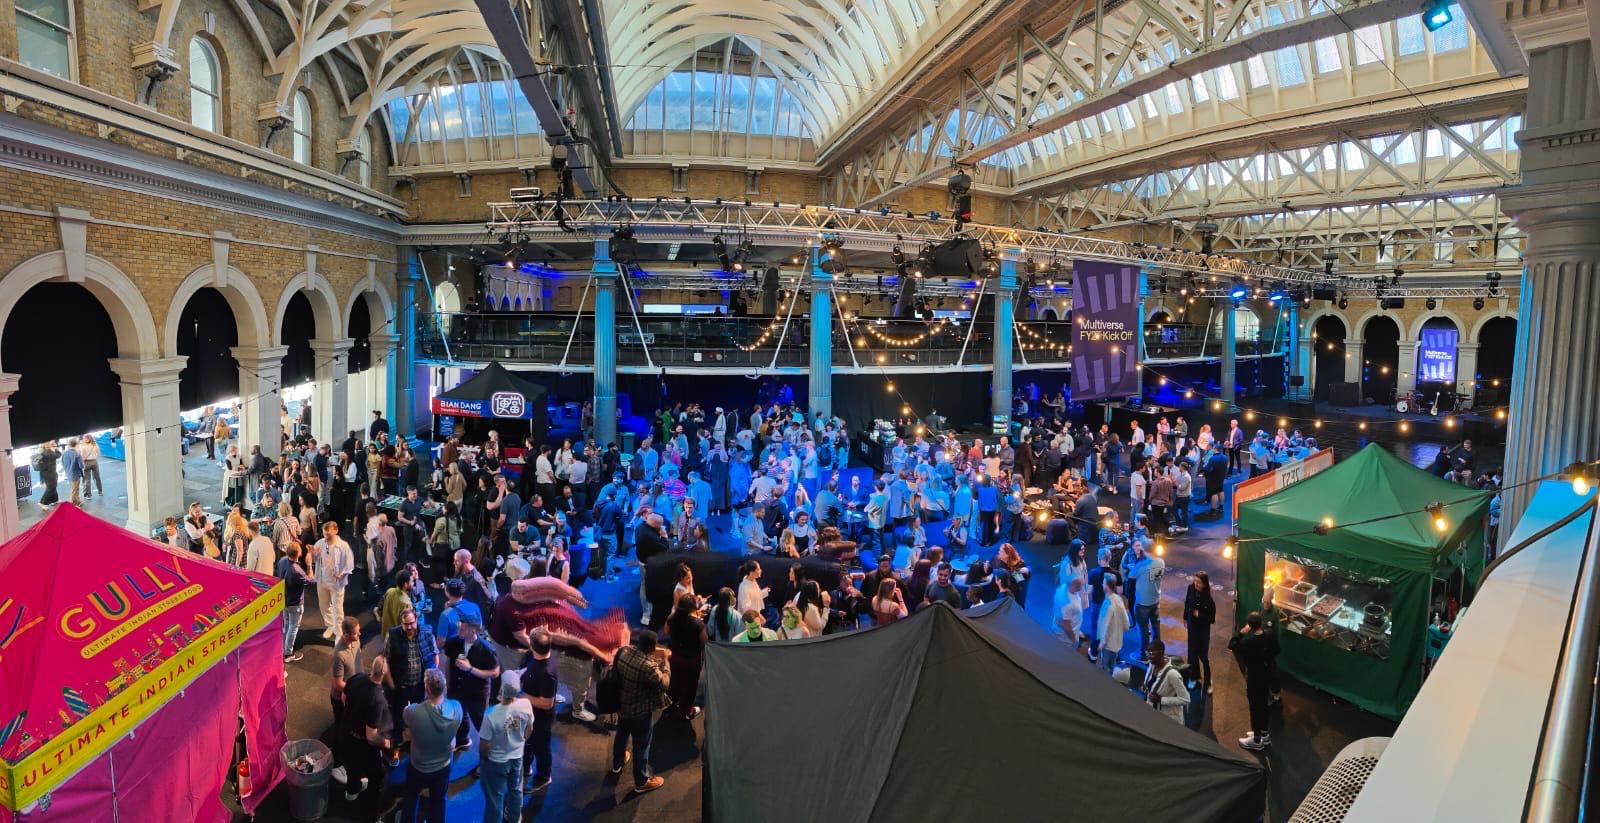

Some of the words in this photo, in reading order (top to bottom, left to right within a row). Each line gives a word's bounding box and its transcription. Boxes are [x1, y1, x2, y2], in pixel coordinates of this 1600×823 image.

[1081, 320, 1124, 329] Multiverse
[1103, 331, 1119, 341] Kick
[1121, 331, 1133, 341] Off
[440, 400, 459, 408] BIAN
[460, 402, 481, 410] DANG
[60, 556, 190, 639] GULLY
[83, 627, 127, 657] ULTIMATE
[128, 608, 157, 629] INDIAN
[159, 594, 182, 611] STREET
[23, 703, 130, 788] ULTIMATE
[139, 655, 195, 705] INDIAN
[202, 618, 249, 657] STREET
[254, 592, 283, 621] FOOD
